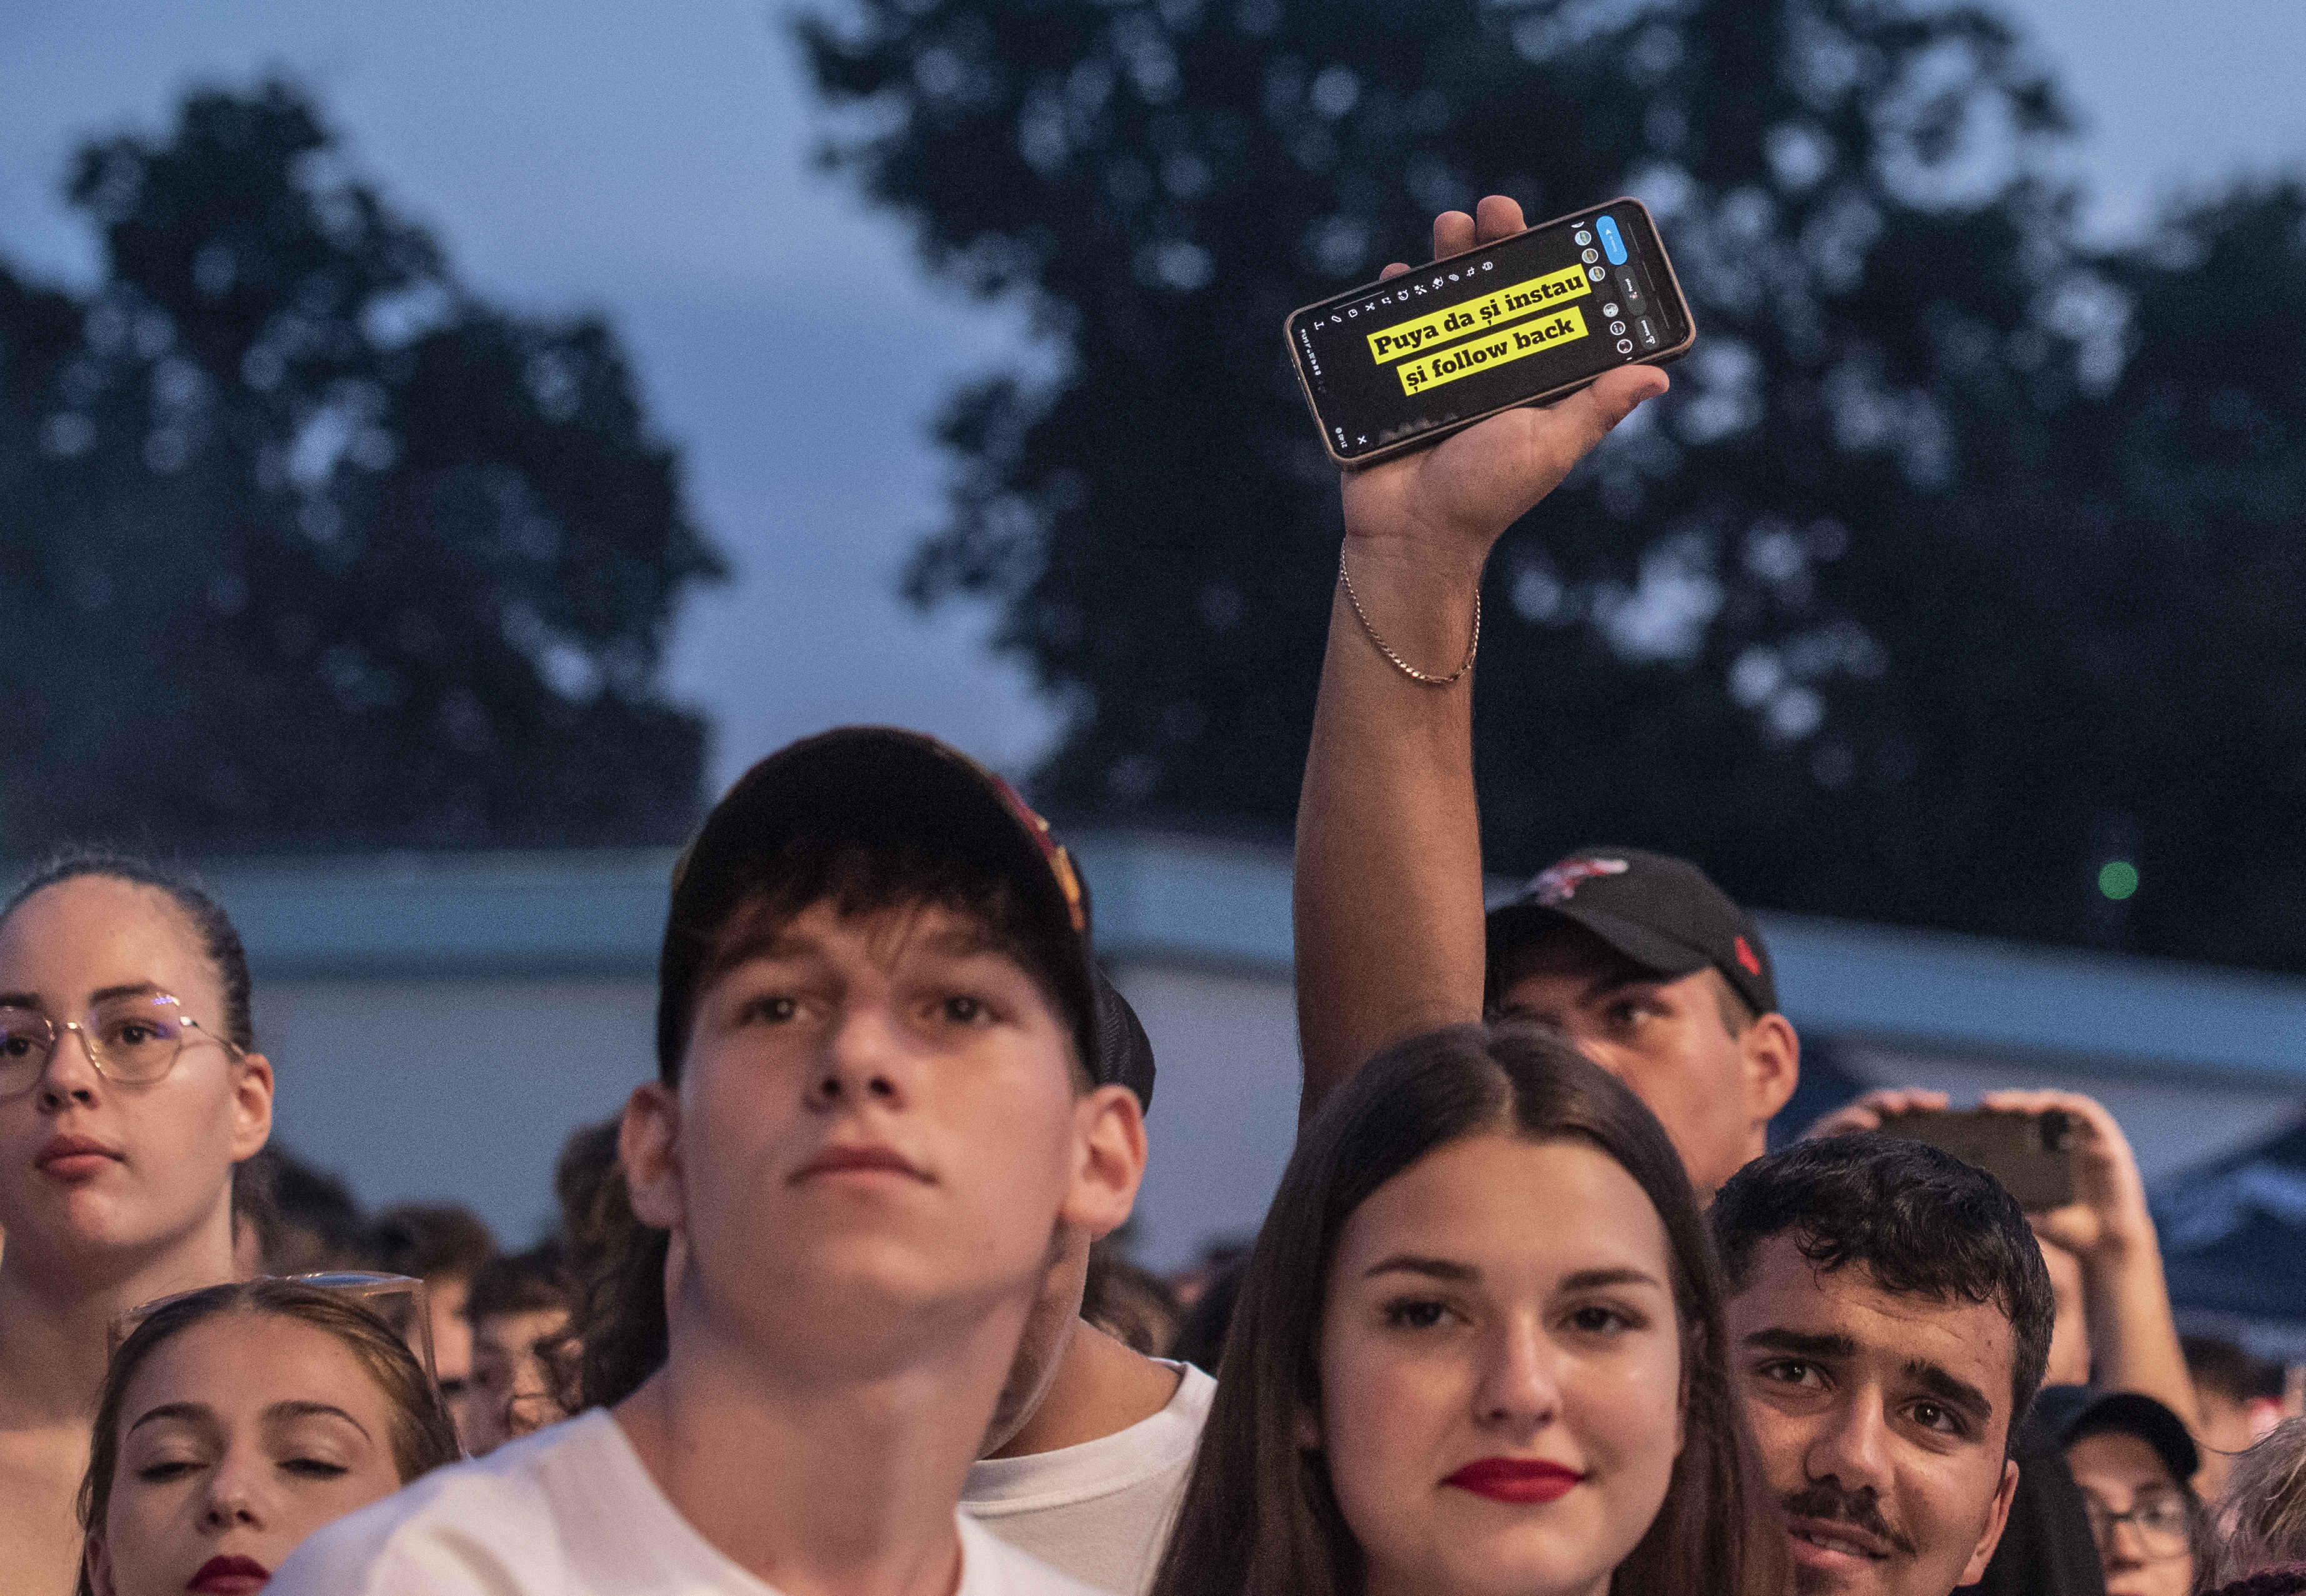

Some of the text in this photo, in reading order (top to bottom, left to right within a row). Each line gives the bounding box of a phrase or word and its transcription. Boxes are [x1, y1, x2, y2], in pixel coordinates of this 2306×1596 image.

[1373, 275, 1584, 356] Puya da și instau
[1405, 318, 1575, 391] și follow back
